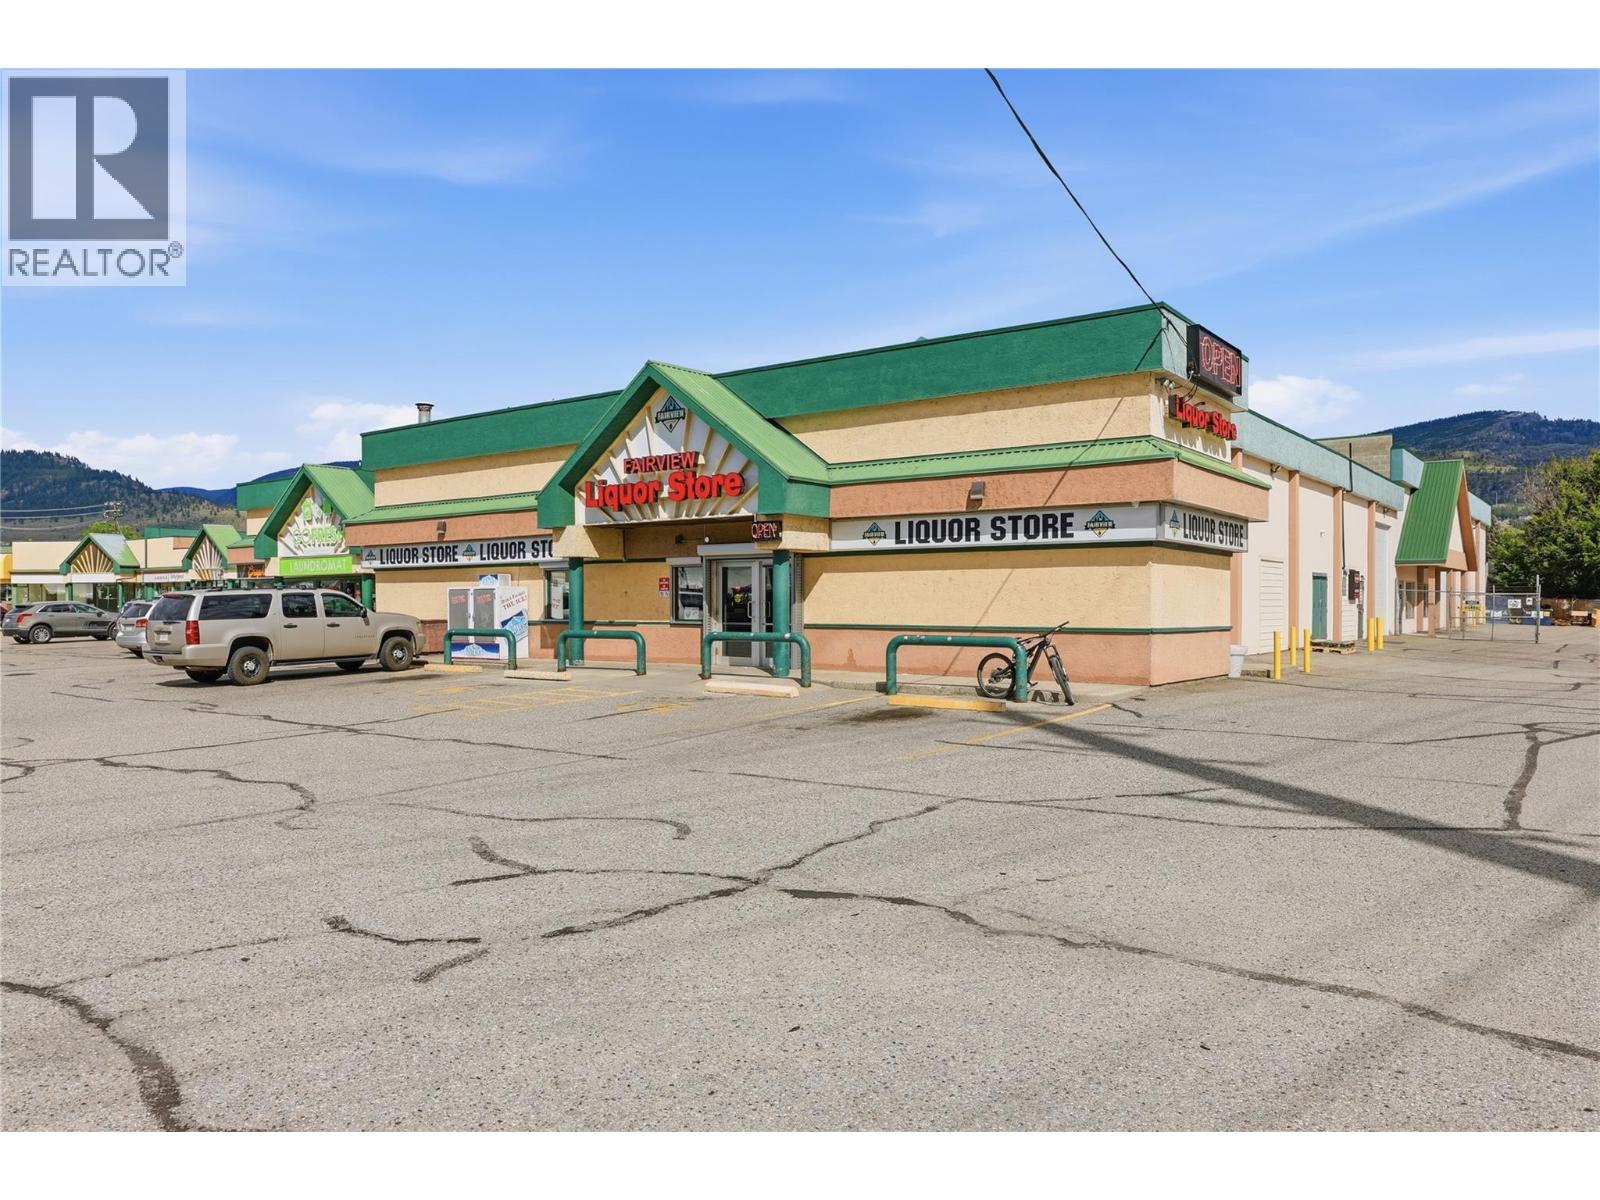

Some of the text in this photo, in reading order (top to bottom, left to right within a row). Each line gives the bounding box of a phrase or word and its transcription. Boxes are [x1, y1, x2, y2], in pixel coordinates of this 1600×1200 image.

[1200, 336, 1241, 387] OPEN
[1212, 410, 1238, 440] Store
[623, 451, 698, 474] FAIRVIEW
[585, 471, 743, 511] Liquor Store
[752, 523, 778, 539] OPEN
[894, 511, 1075, 545] LIQUOR STORE
[1183, 512, 1244, 548] LIQUOR STORE
[289, 559, 346, 573] LAUNDROMAT
[379, 546, 419, 565] LIQUOR
[422, 544, 459, 563] STORE
[480, 540, 526, 561] LIQUOR
[502, 601, 515, 610] THE
